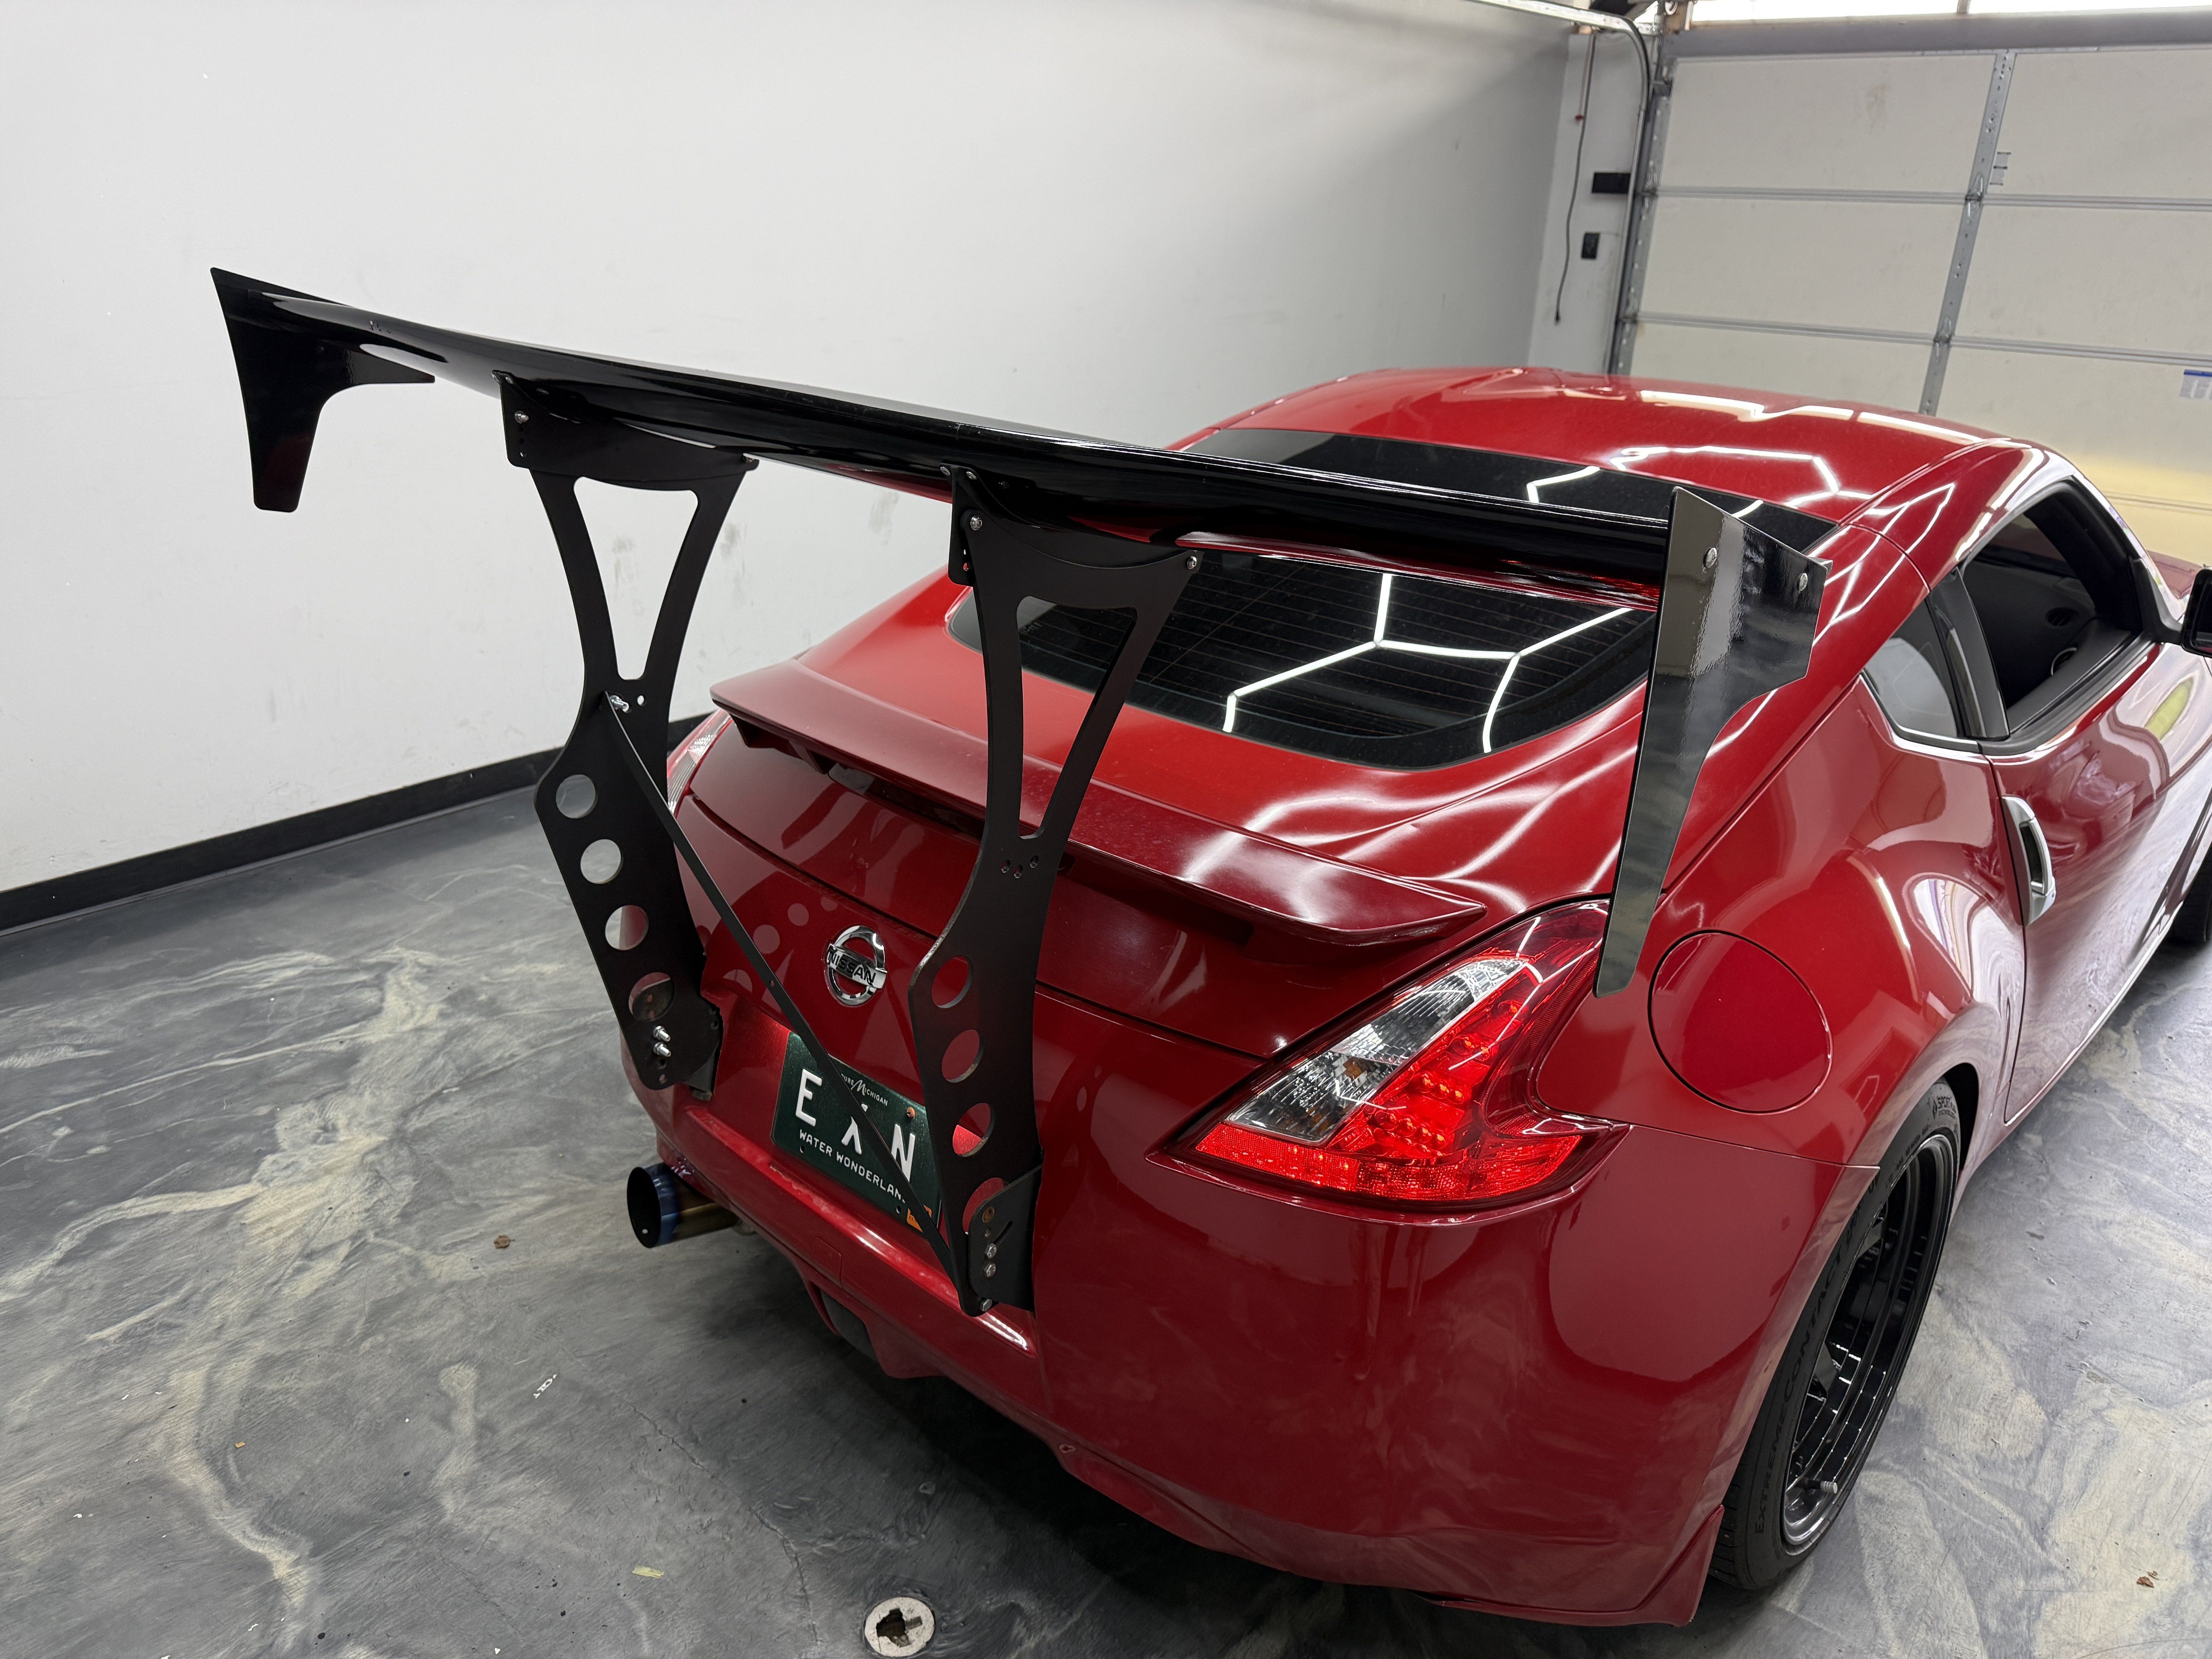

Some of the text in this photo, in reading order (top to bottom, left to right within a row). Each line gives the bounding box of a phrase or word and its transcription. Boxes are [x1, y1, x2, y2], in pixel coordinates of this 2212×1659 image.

[828, 951, 876, 983] NISSAN
[851, 1079, 888, 1106] MICHIGAN
[800, 1129, 905, 1203] WATER WONDERLAN
